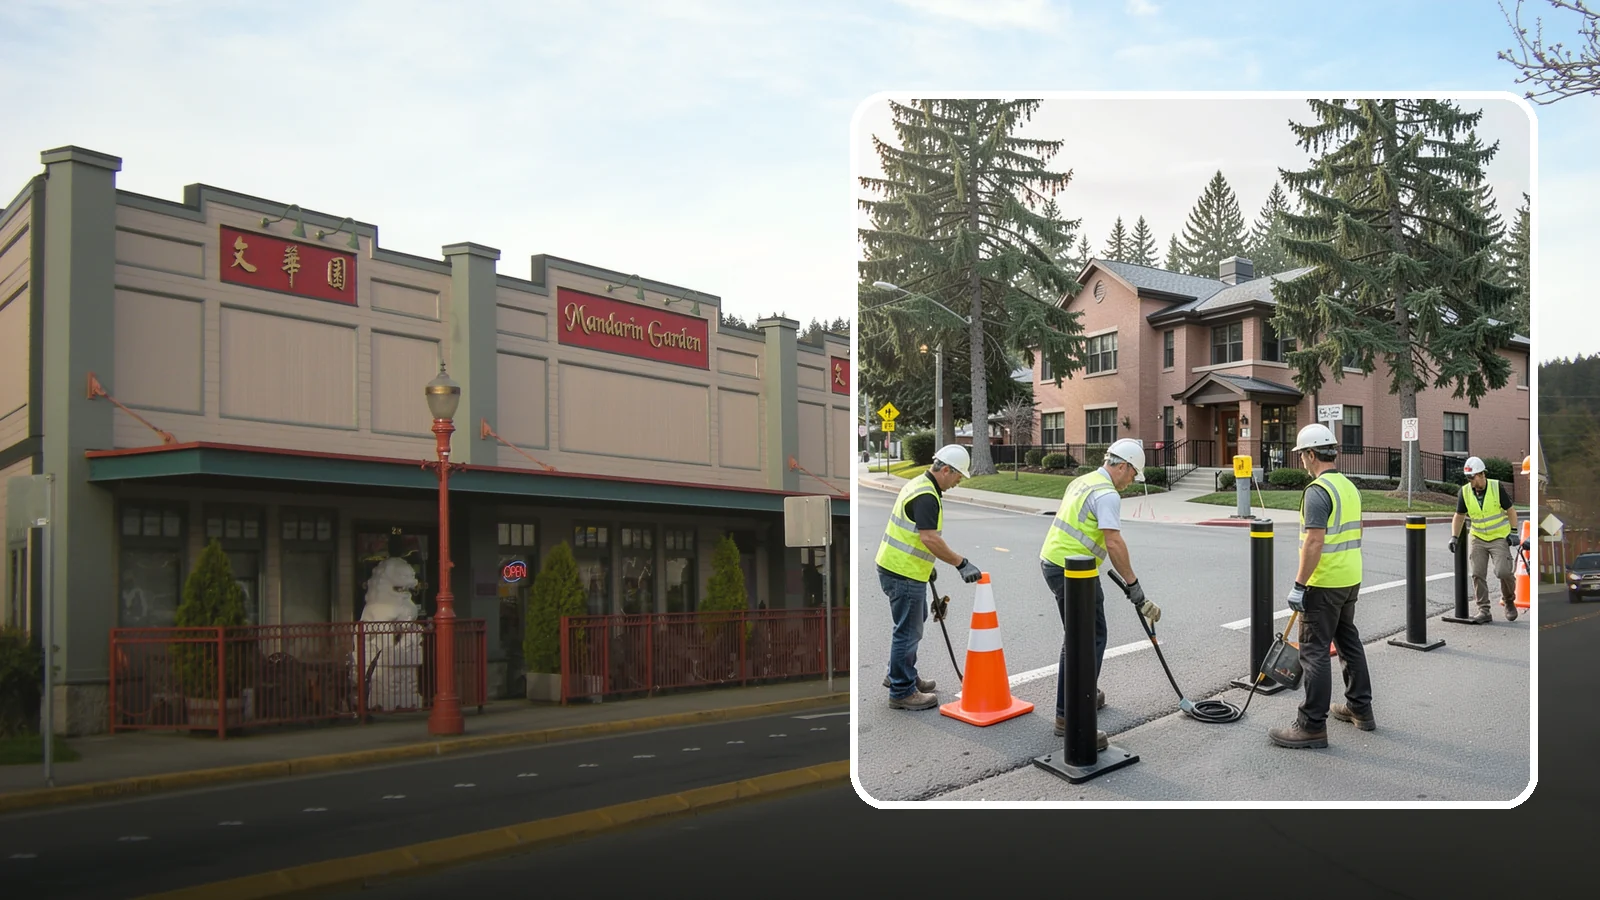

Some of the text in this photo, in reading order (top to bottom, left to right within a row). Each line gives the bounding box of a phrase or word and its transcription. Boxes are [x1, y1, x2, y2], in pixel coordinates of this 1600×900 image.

[230, 235, 346, 291] 文華園
[564, 302, 701, 352] Mandarin Garden
[503, 565, 527, 578] OPEN
